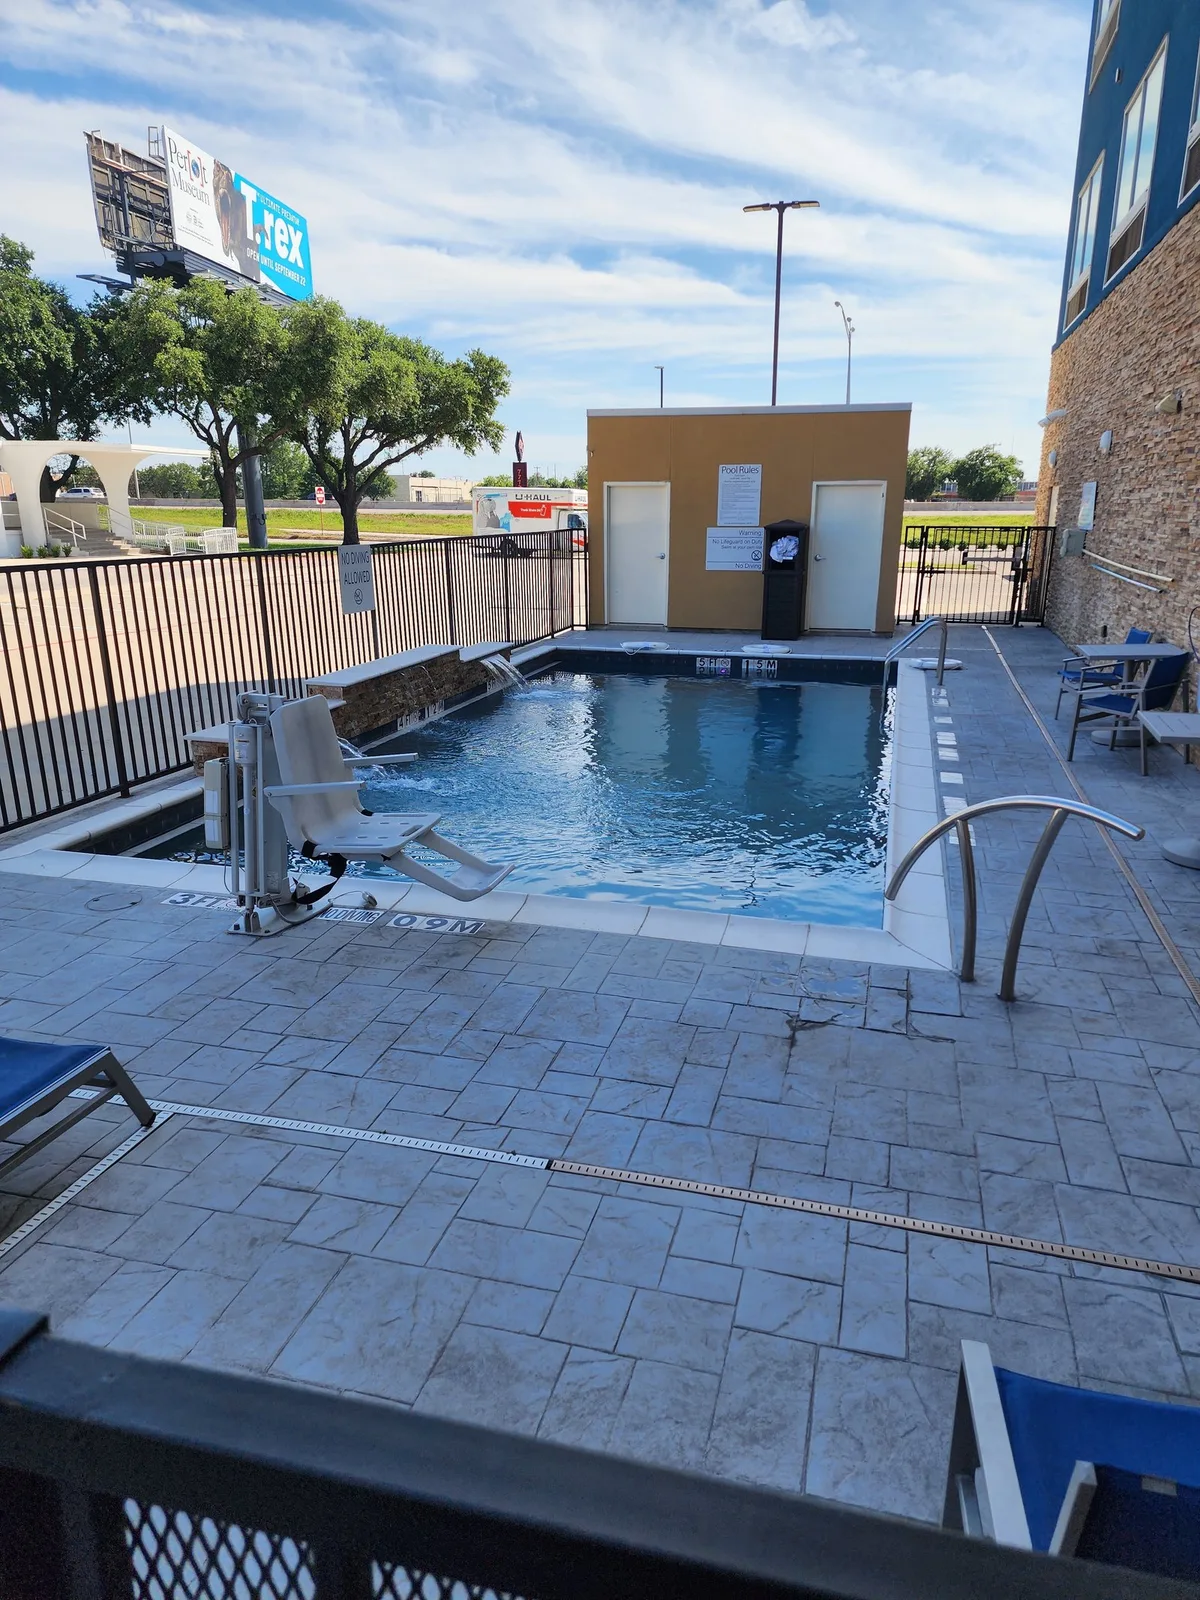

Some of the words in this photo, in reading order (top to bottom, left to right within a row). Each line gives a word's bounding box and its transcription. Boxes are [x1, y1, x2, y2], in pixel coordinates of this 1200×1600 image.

[171, 167, 211, 205] Museum
[246, 247, 260, 262] OPEN
[260, 255, 274, 270] UNTIL
[274, 262, 300, 283] SEPTEMBER
[300, 276, 306, 287] 22
[721, 465, 738, 474] Pool
[739, 465, 759, 474] Rules
[341, 552, 350, 565] NO
[350, 550, 370, 565] DIVING
[343, 570, 371, 585] ALLOWED
[168, 893, 196, 904] 3
[333, 909, 381, 923] DIVING
